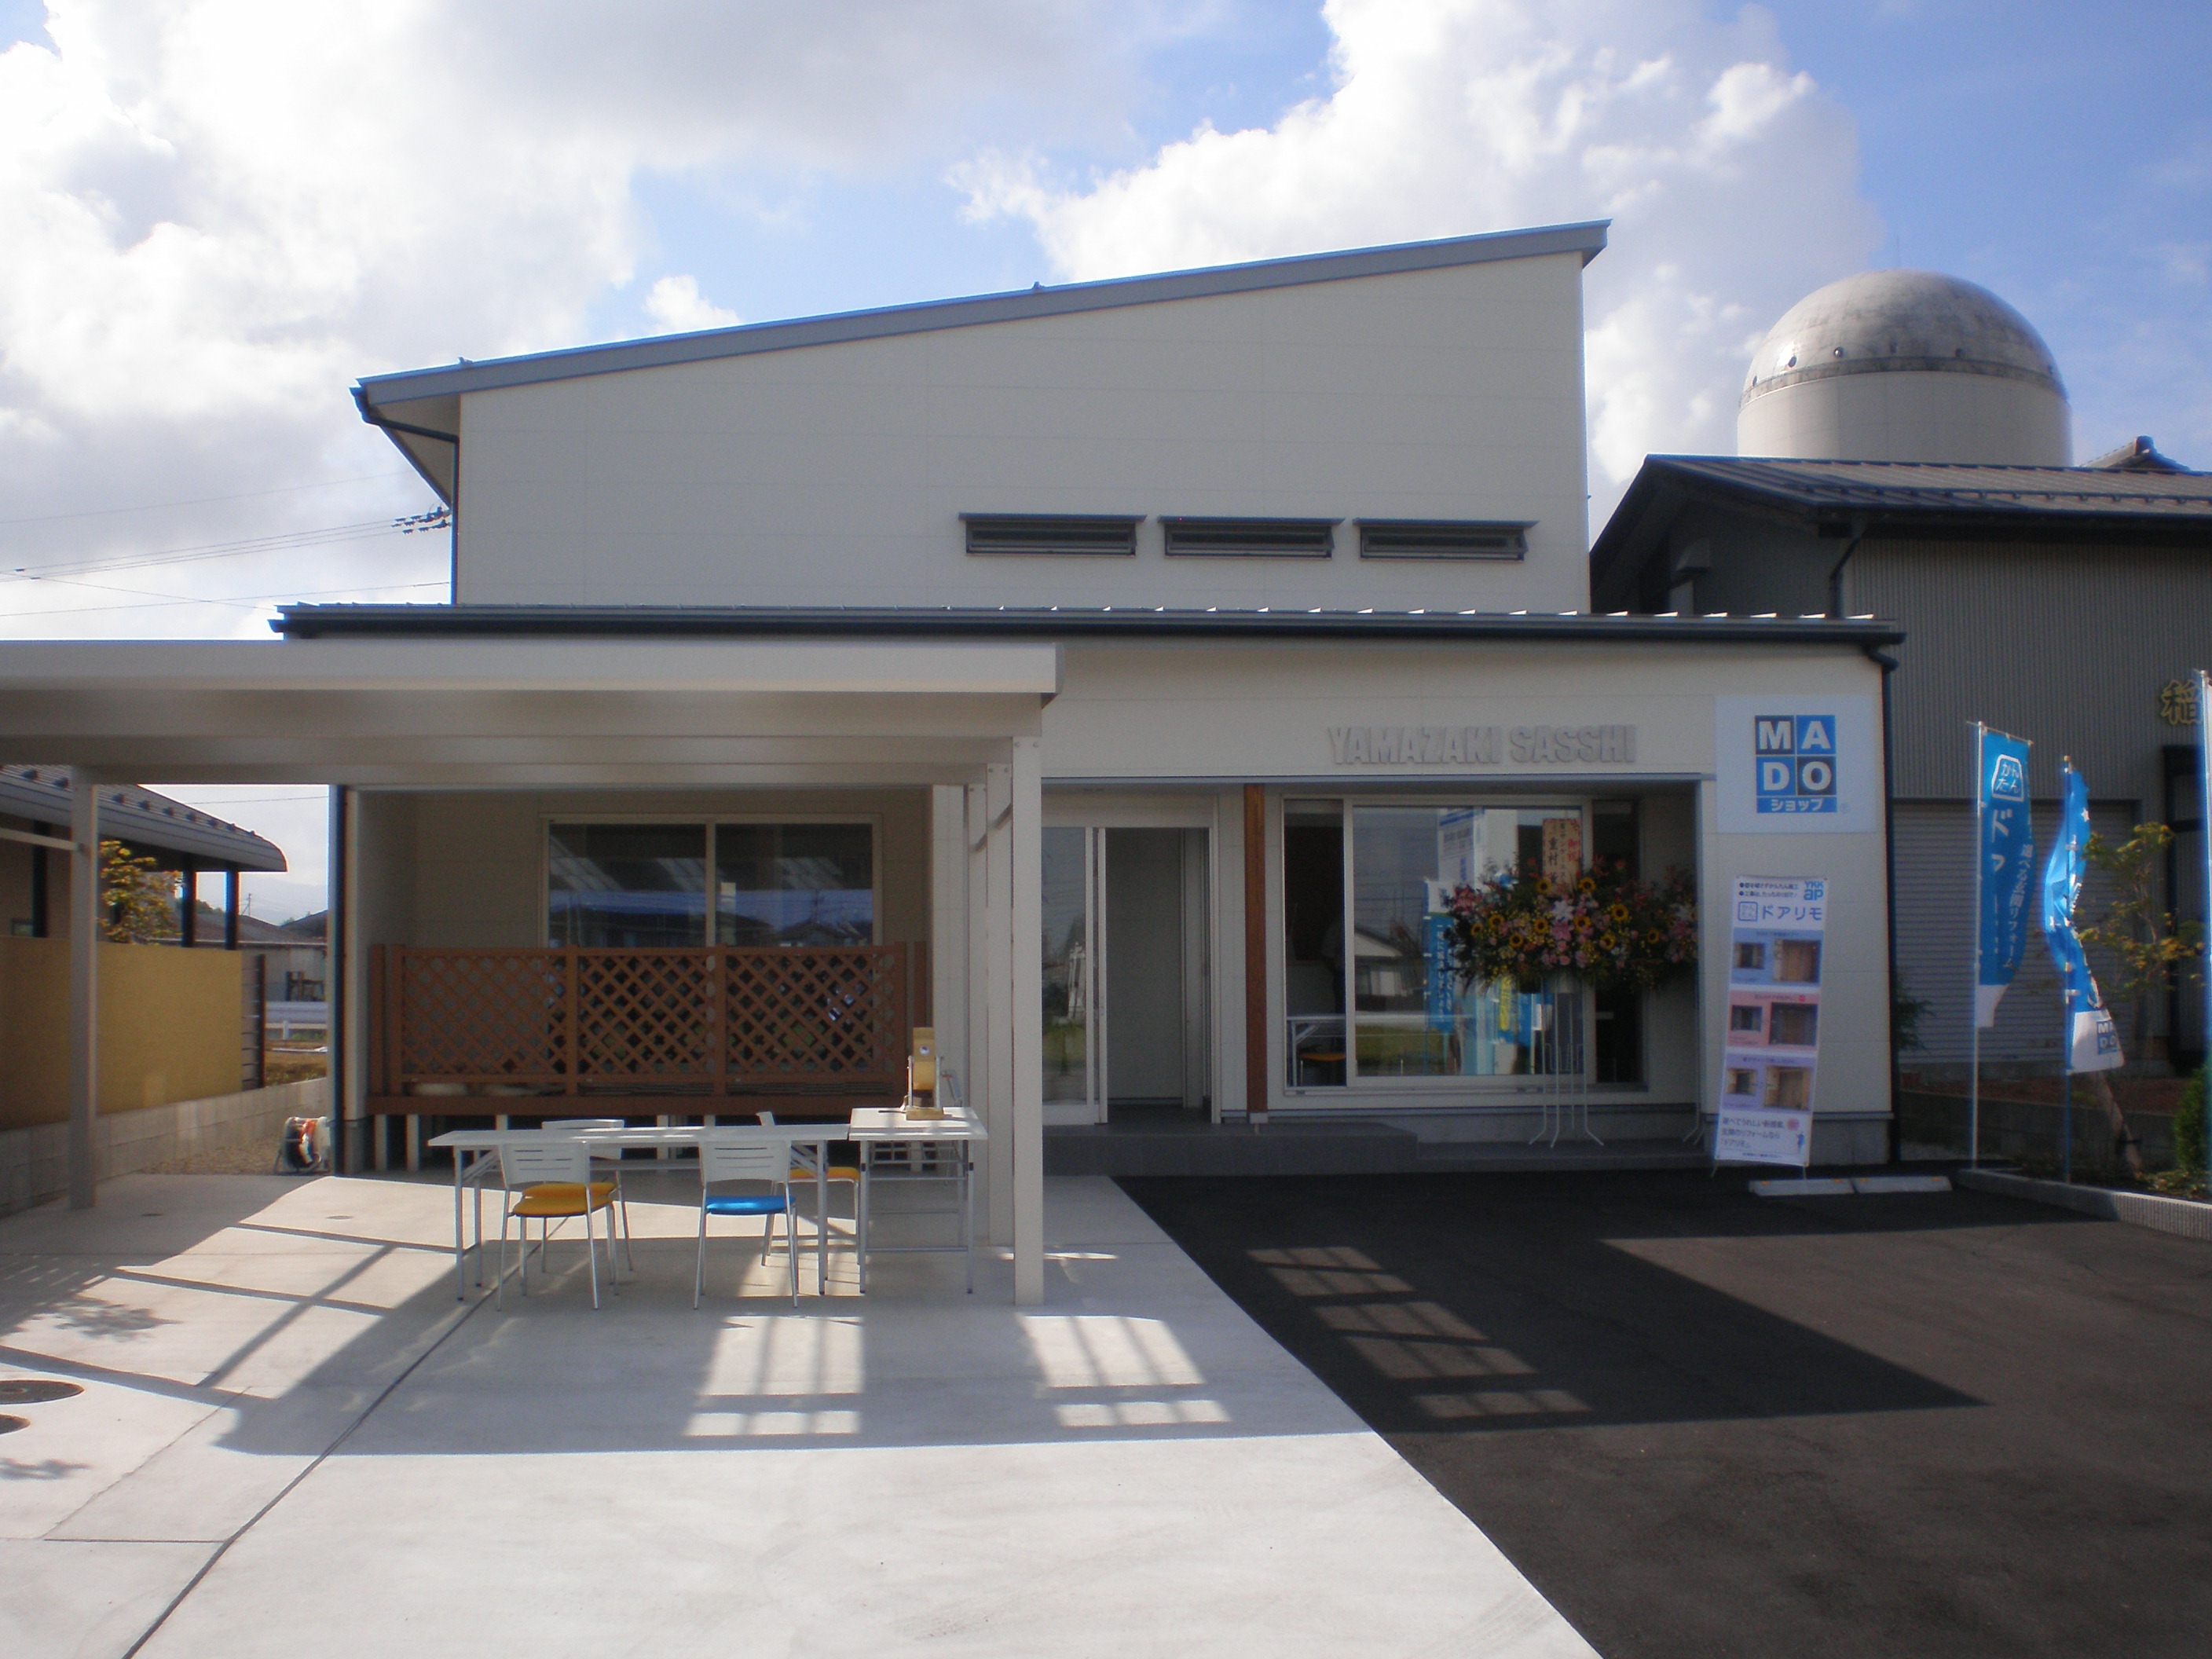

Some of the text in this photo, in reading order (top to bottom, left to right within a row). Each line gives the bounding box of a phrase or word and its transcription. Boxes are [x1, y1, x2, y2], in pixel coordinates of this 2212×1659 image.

[1327, 723, 1637, 765] YAMAZAKI SASSHI
[1771, 798, 1823, 812] ショップ
[1804, 881, 1824, 889] YKK
[1804, 888, 1823, 901] ap
[1763, 904, 1822, 921] ドアリモ
